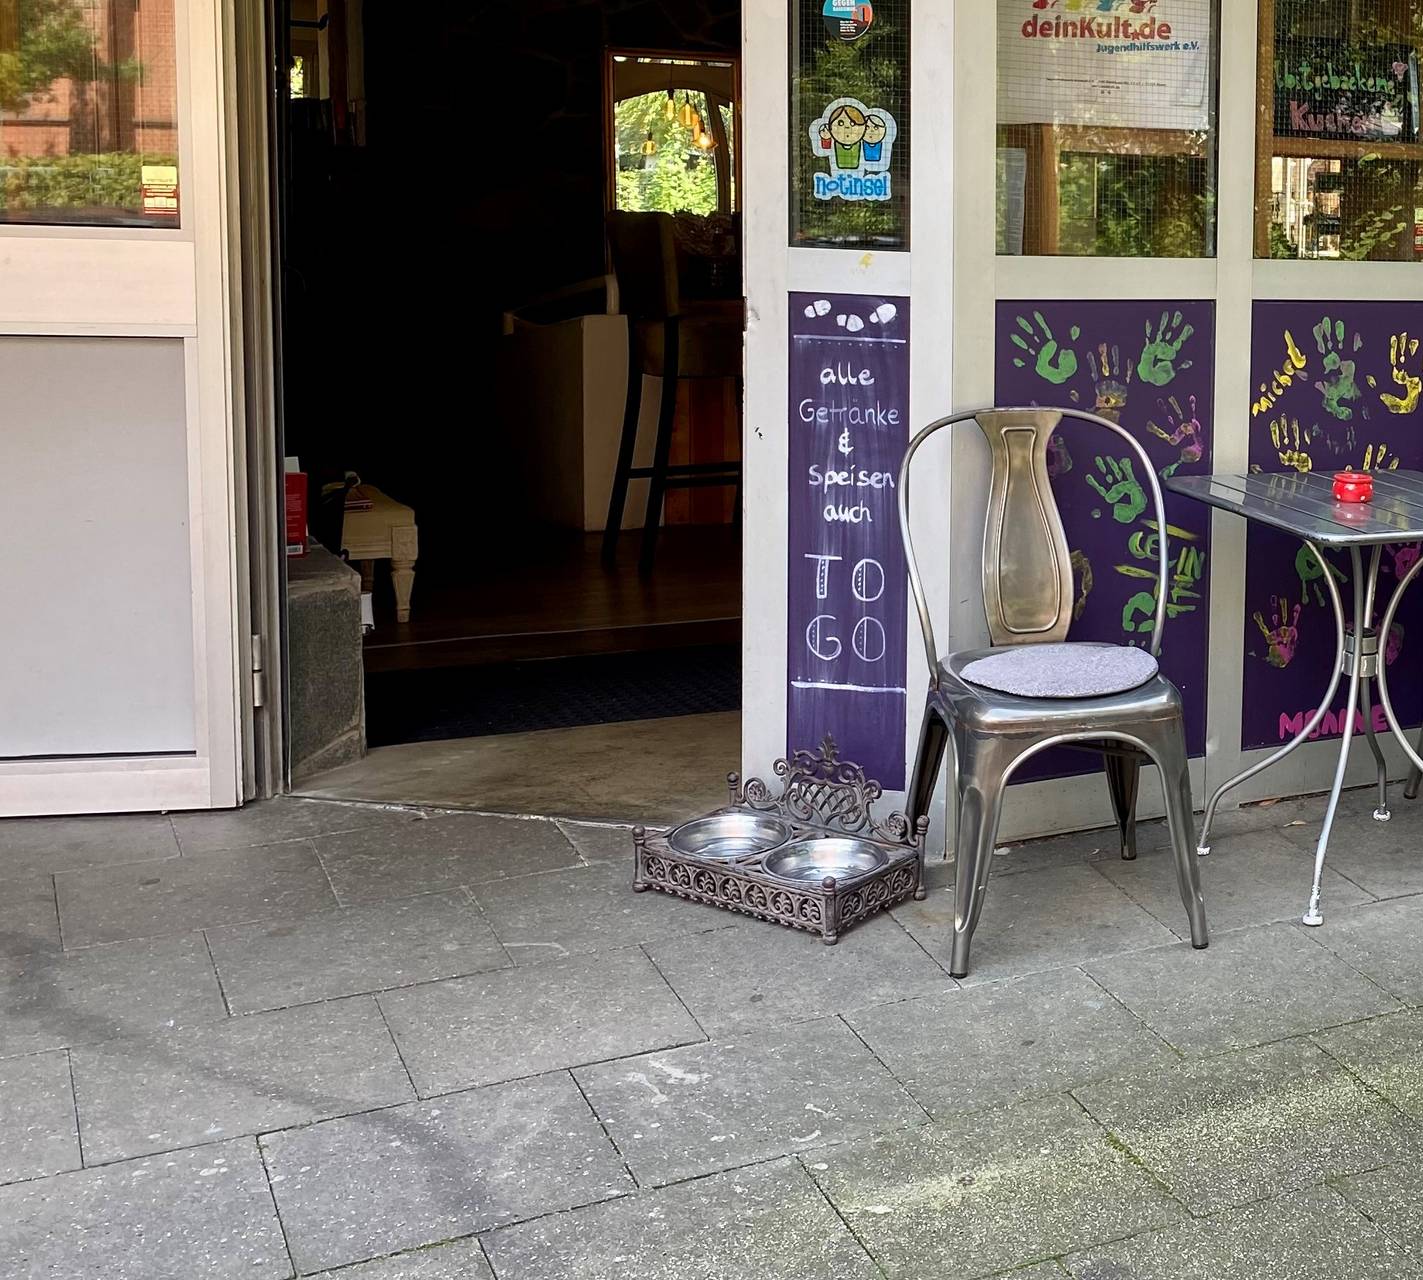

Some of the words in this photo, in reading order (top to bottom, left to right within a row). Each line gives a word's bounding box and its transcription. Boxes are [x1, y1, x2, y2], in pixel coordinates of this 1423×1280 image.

[1096, 42, 1180, 54] Jugendhilfswerk
[815, 174, 888, 196] notinsel
[820, 361, 874, 385] alle
[799, 398, 900, 425] Getränke
[808, 464, 895, 495] Speisen
[823, 500, 872, 524] auch
[804, 553, 885, 602] TO
[806, 614, 886, 662] GO
